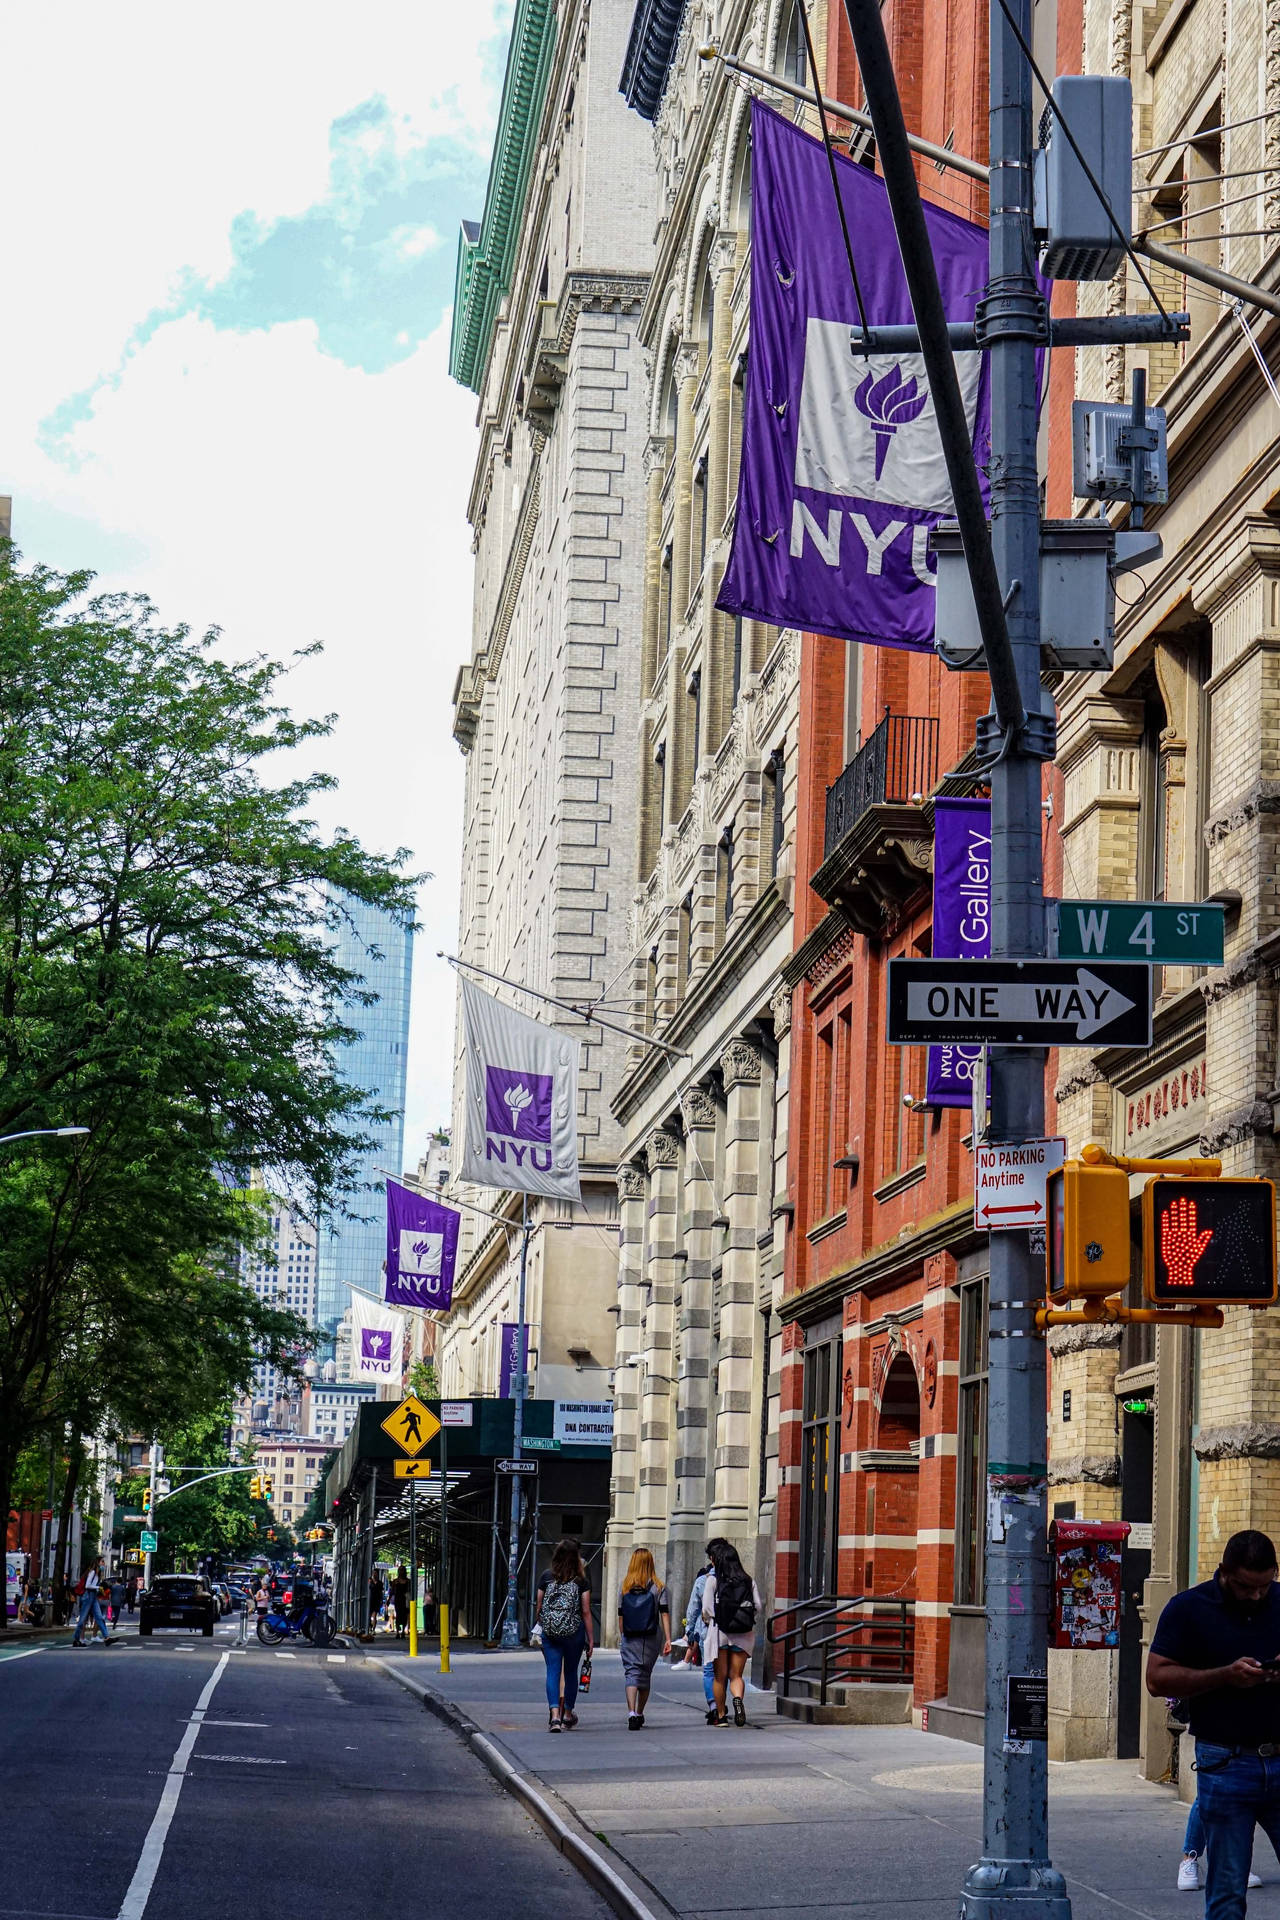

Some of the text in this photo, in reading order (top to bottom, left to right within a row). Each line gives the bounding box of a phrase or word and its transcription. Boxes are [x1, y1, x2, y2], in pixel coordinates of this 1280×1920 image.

[960, 829, 992, 942] Gallery
[1077, 909, 1200, 955] W 4 ST
[927, 986, 1110, 1020] ONE WAY
[486, 1137, 552, 1172] NYU
[980, 1148, 1045, 1168] NO PARKING
[981, 1170, 1025, 1190] Anytime
[397, 1273, 441, 1294] NYU
[361, 1359, 392, 1373] NYU
[565, 1423, 577, 1432] DNA
[523, 1439, 554, 1449] WASHINGTON
[519, 1462, 532, 1470] WAY
